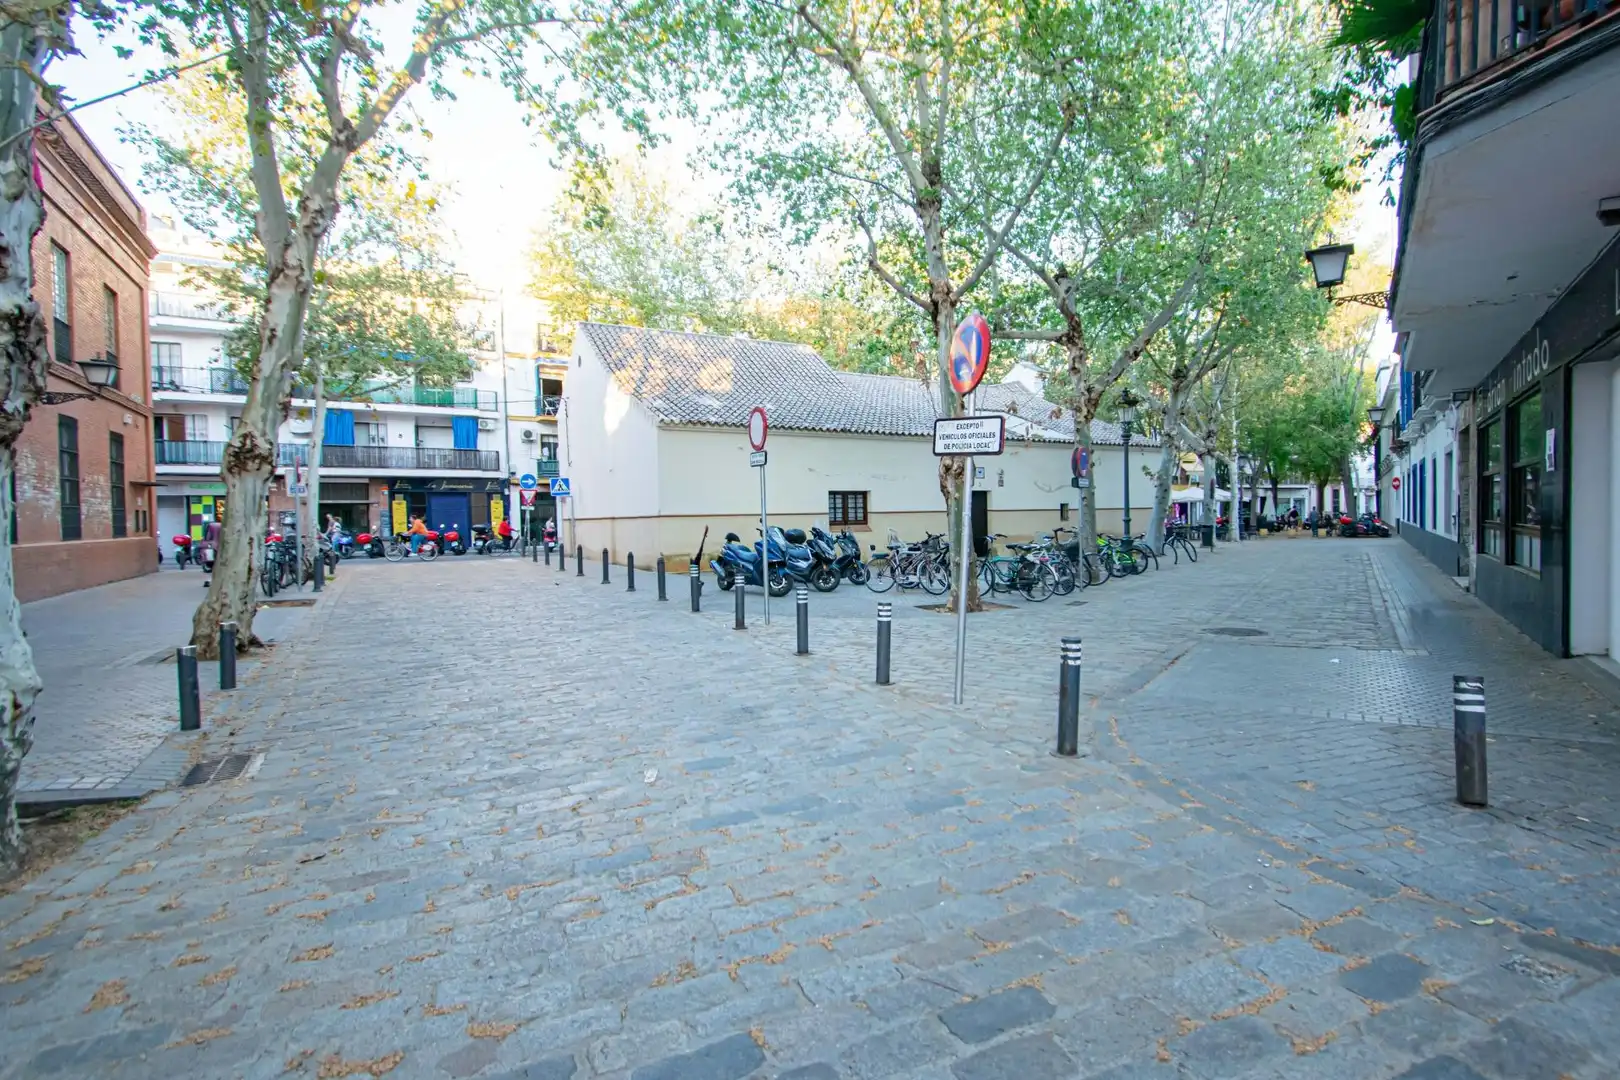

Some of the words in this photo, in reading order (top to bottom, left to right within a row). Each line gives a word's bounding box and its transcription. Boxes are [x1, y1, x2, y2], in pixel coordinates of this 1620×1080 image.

[956, 422, 980, 430] EXCEPTO
[939, 432, 967, 440] VEHICULOS
[968, 431, 996, 439] OFICIALES
